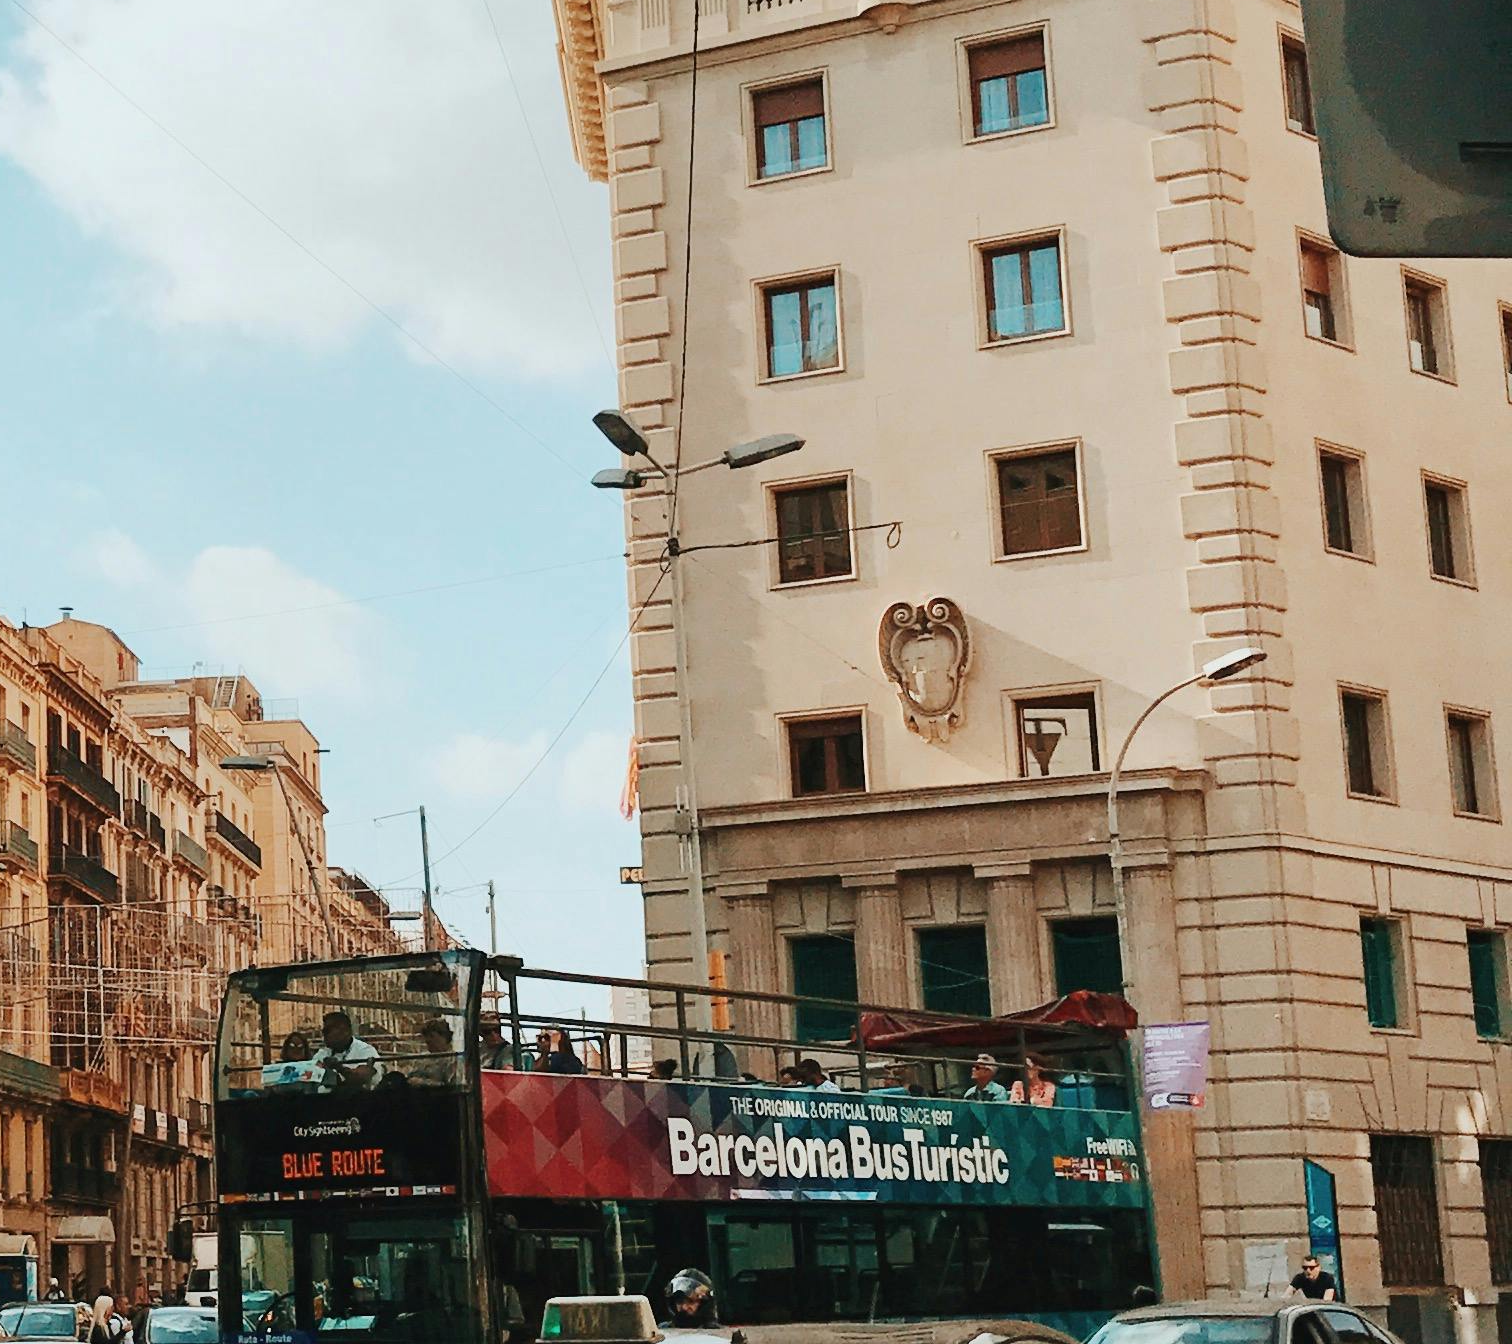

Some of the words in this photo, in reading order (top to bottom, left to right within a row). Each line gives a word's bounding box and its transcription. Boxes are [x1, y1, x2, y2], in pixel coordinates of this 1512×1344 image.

[729, 1096, 754, 1115] THE
[754, 1098, 809, 1118] ORIGINAL
[810, 1101, 819, 1118] &
[818, 1101, 868, 1121] OFFICIAL
[868, 1104, 899, 1123] TOUR
[900, 1106, 931, 1125] SINCE
[931, 1109, 953, 1126] 1987
[667, 1117, 849, 1179] Barcelona
[282, 1152, 324, 1179] BLUE
[331, 1148, 385, 1176] ROUTE
[265, 1334, 293, 1344] Route
